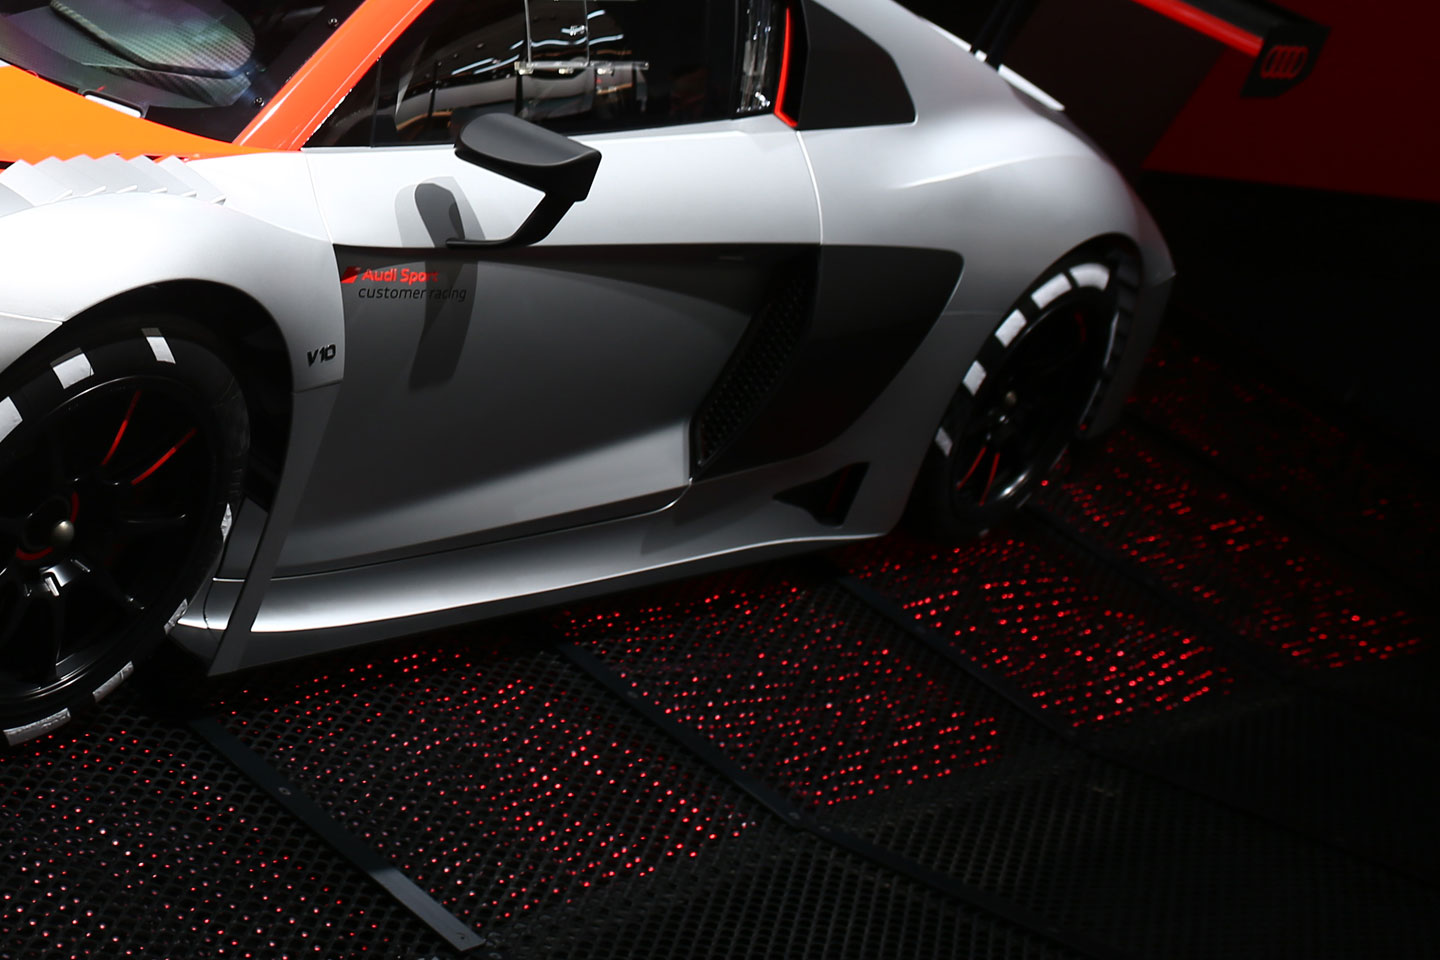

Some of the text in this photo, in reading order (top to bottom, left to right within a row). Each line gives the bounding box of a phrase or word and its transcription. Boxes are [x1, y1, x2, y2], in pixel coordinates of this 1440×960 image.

[362, 268, 438, 284] Audi Sport
[358, 287, 467, 302] customer racing
[307, 344, 336, 366] V10
